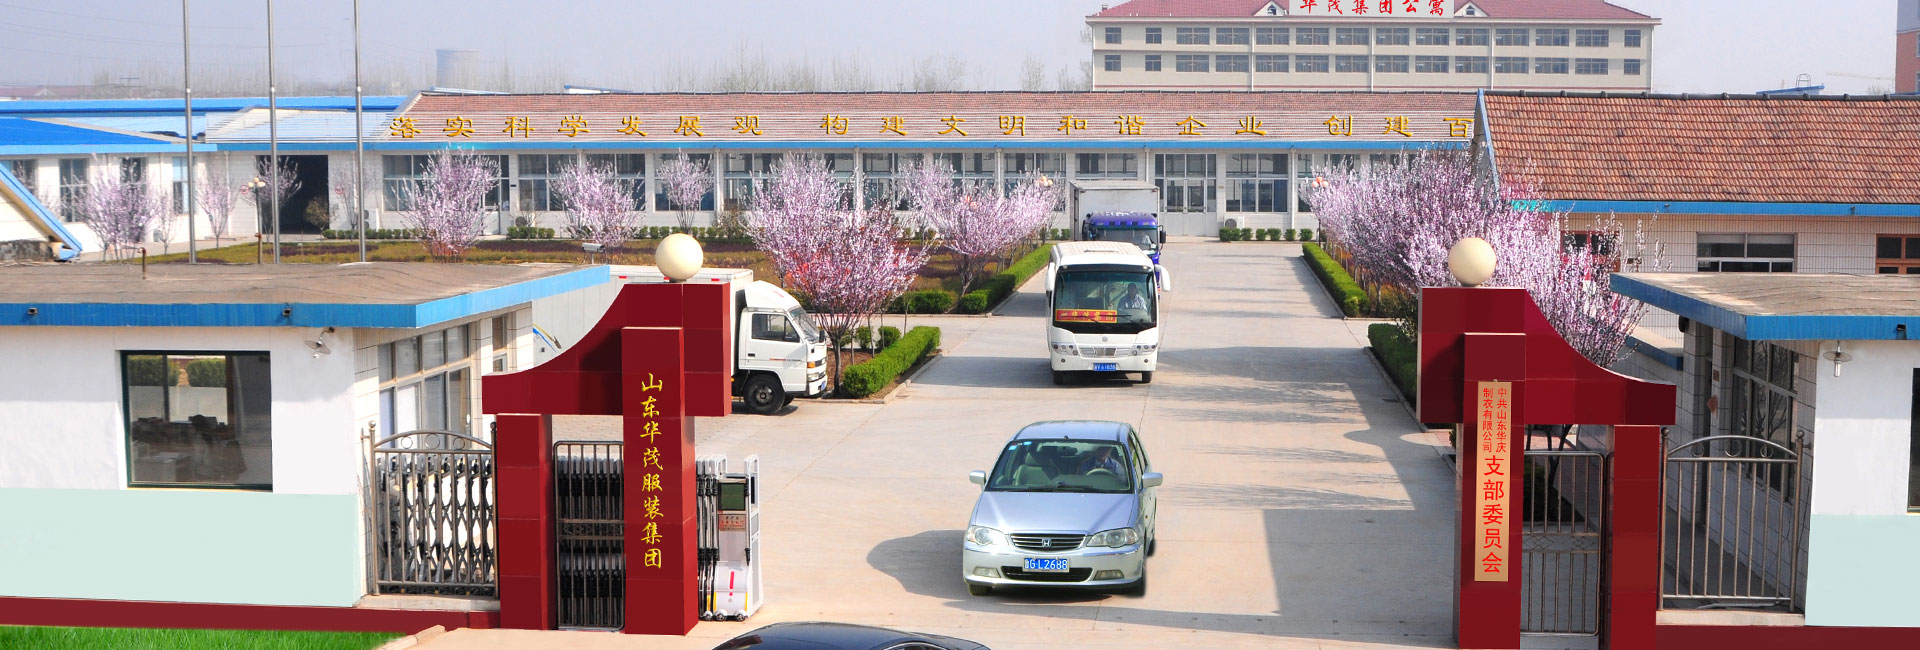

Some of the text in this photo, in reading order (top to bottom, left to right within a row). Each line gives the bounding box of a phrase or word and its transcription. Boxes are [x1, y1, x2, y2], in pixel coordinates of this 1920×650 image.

[389, 113, 1475, 138] 落实科学发展观 构建文明和谐企业 创建百
[1482, 387, 1494, 453] 制衣有限公司
[1496, 387, 1508, 453] 中共山东华庆
[640, 372, 664, 569] 山东华茂服装集团
[1482, 454, 1505, 573] 支部委员会
